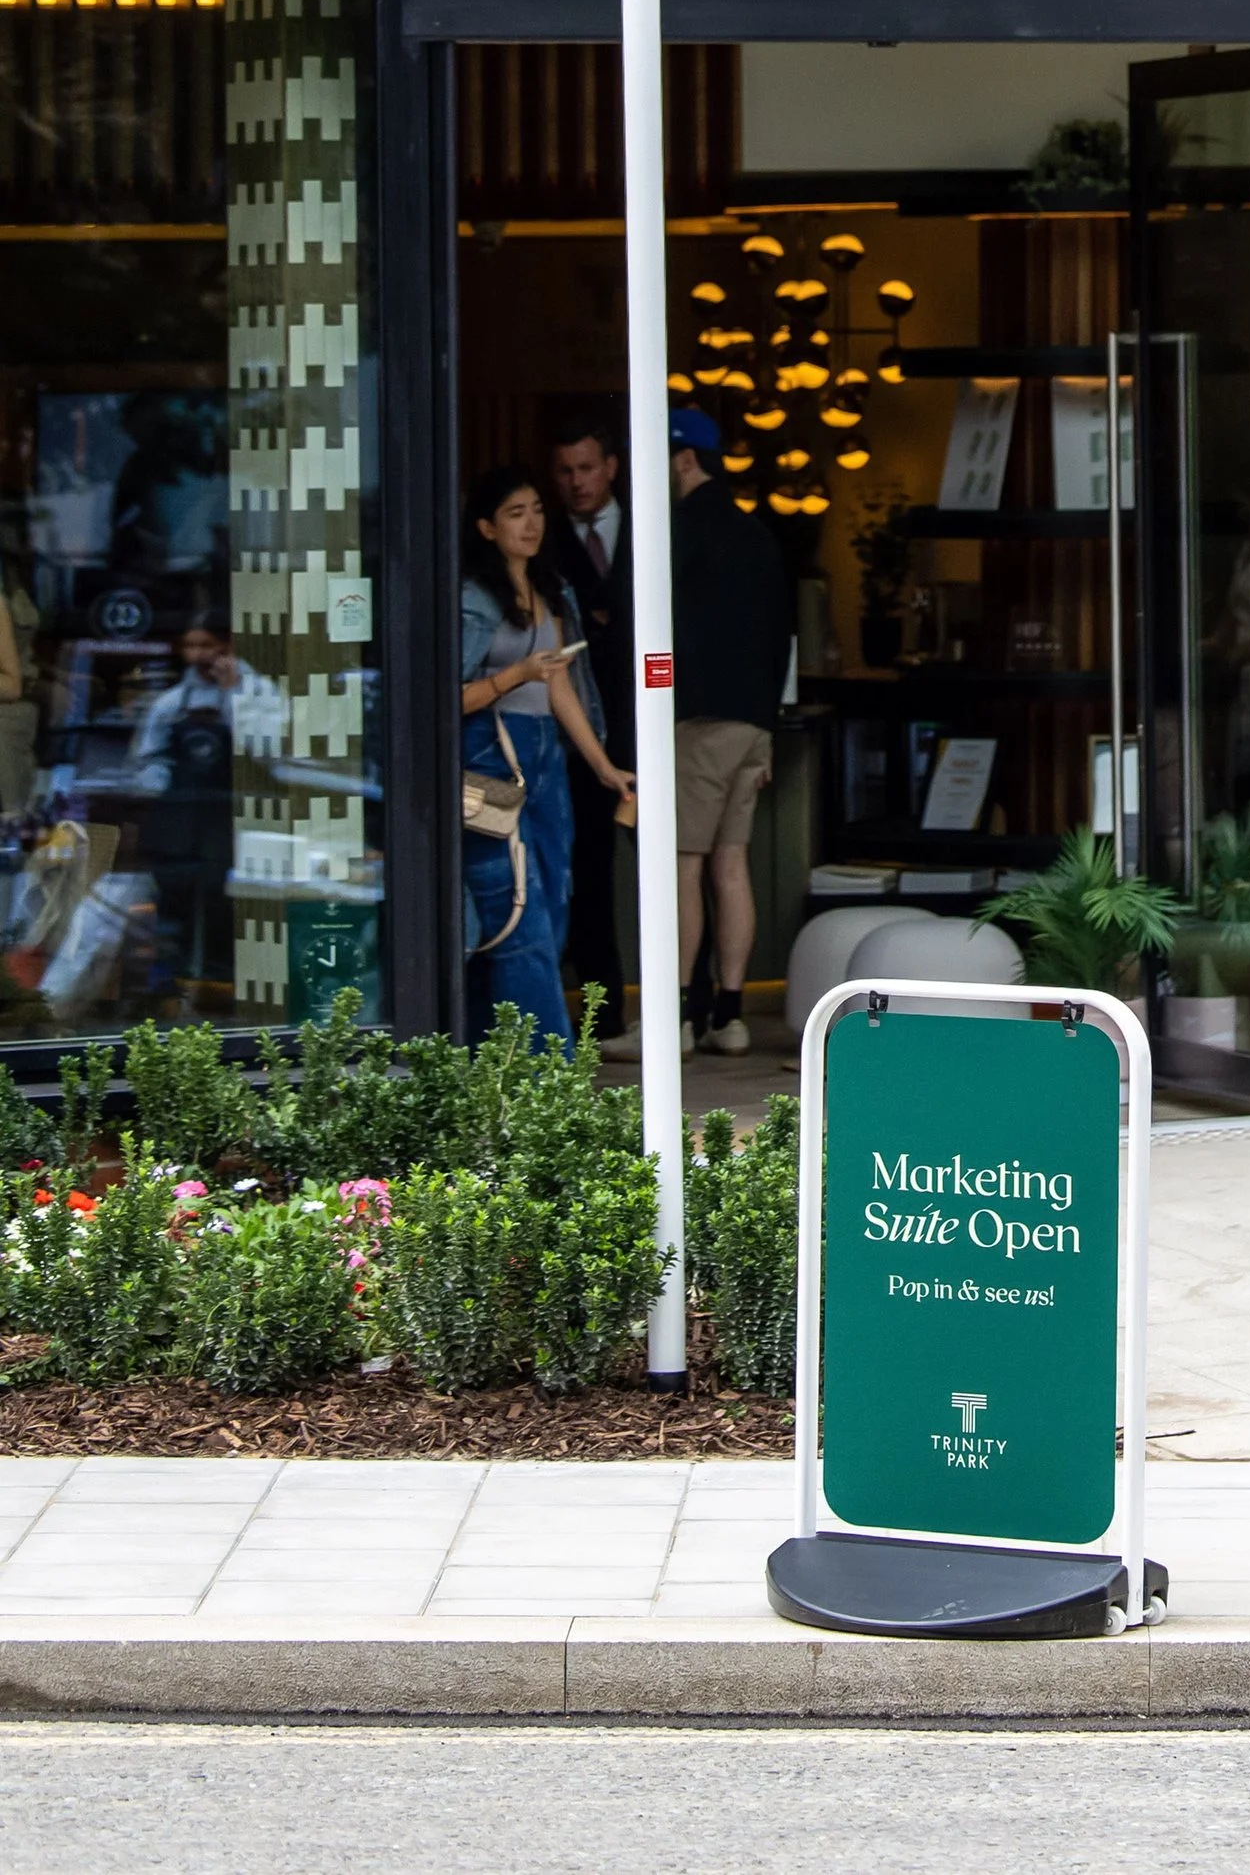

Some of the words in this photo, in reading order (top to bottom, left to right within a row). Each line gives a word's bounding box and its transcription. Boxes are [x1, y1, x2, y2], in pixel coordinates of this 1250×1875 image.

[872, 1152, 1073, 1212] Marketing
[864, 1202, 960, 1245] Suite
[968, 1208, 1081, 1260] Open
[888, 1274, 930, 1303] Pop
[934, 1278, 953, 1300] in
[957, 1279, 980, 1301] &
[984, 1287, 1021, 1304] see
[1024, 1285, 1055, 1307] us!
[931, 1434, 1007, 1455] TRINITY
[947, 1452, 989, 1470] PARK
